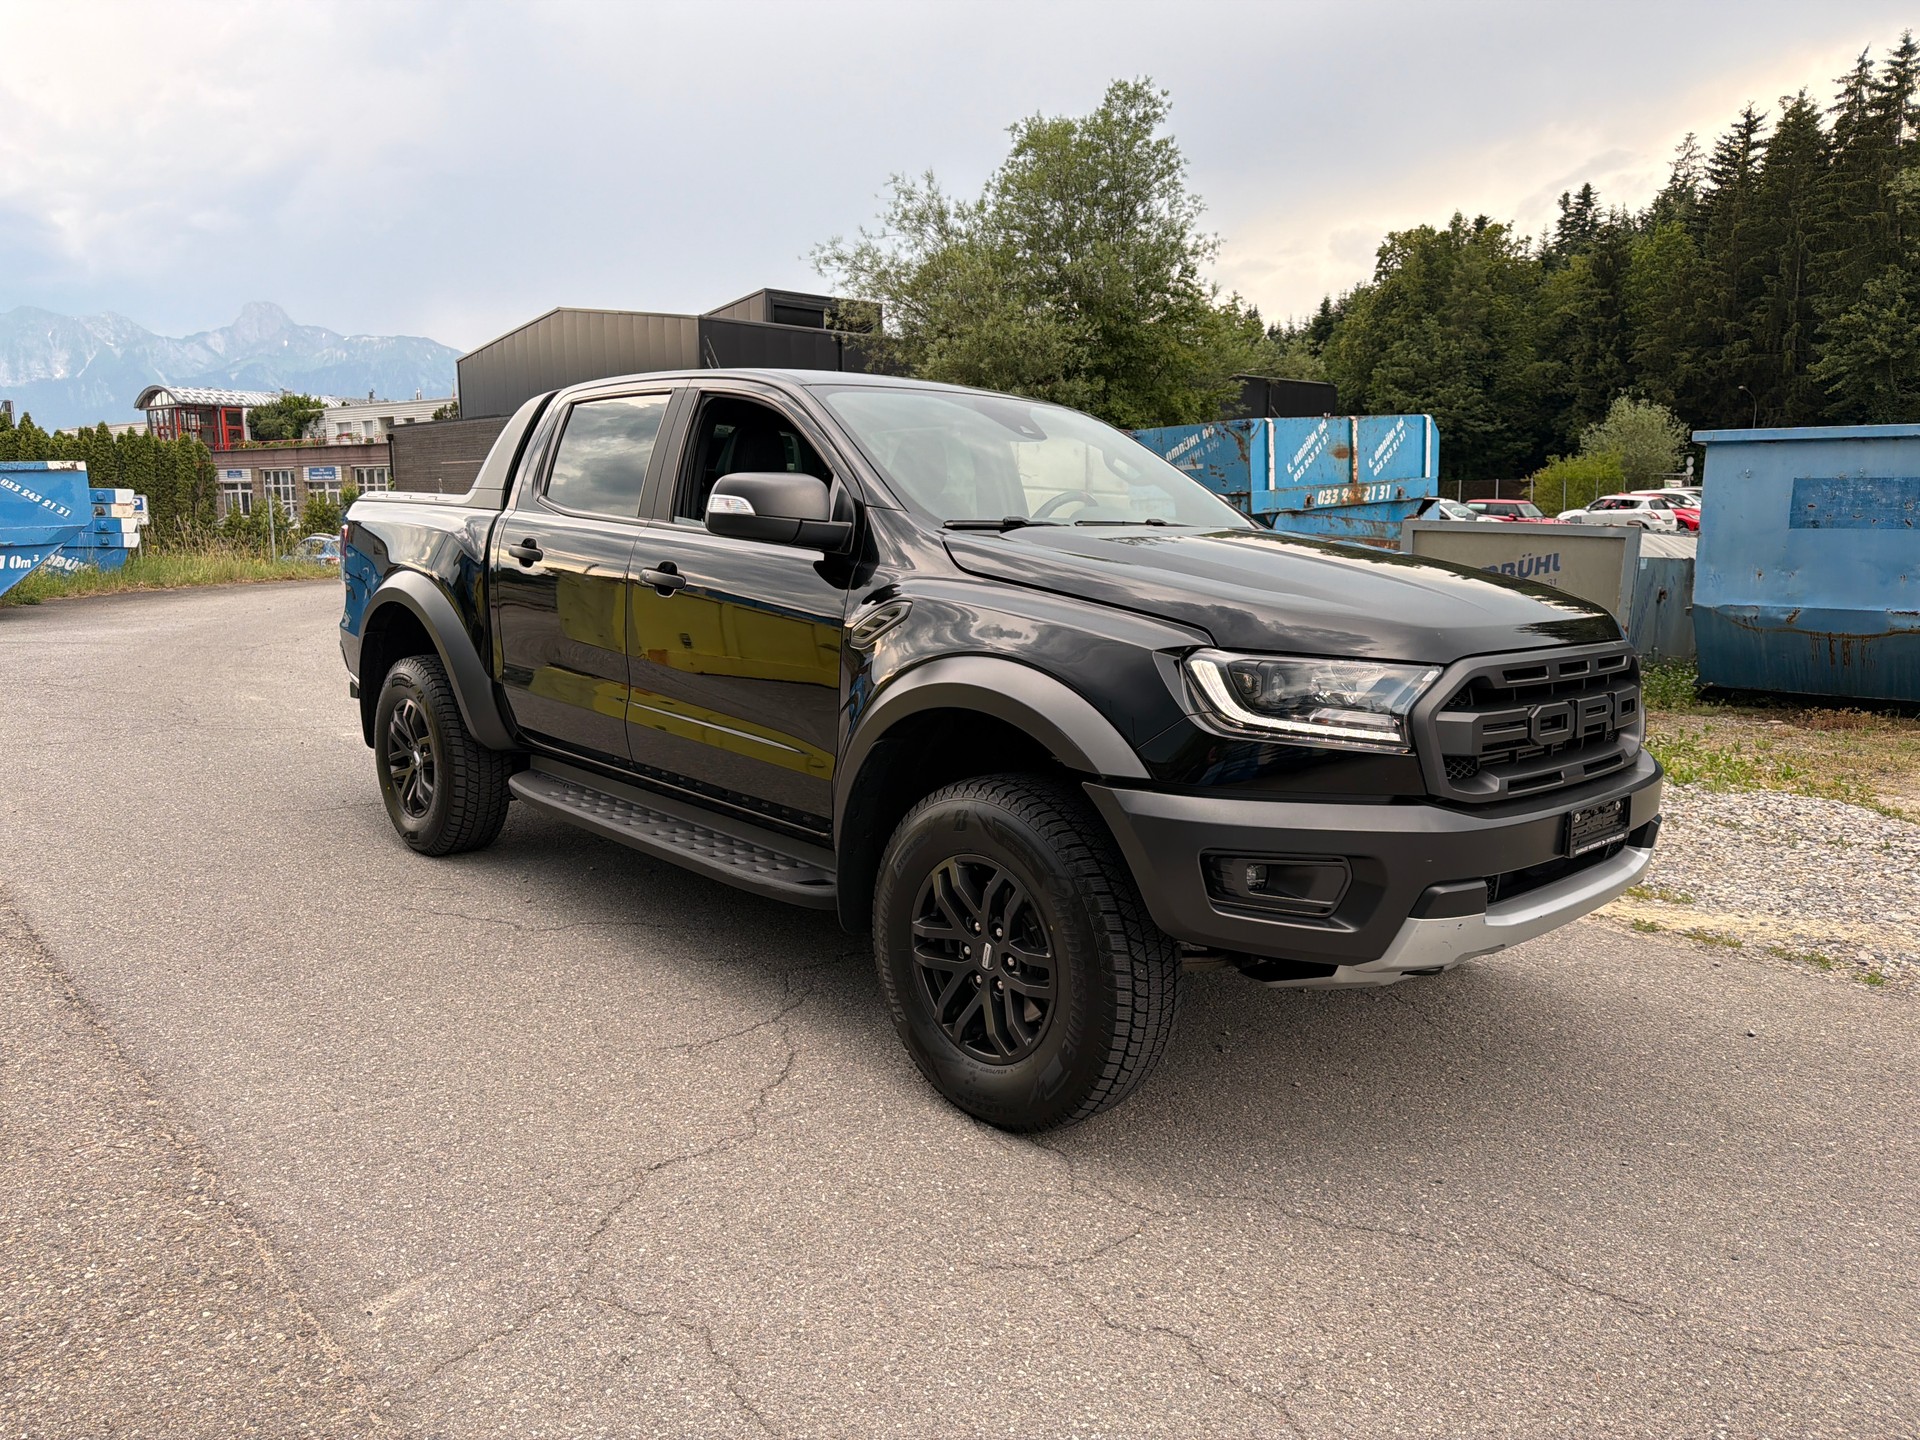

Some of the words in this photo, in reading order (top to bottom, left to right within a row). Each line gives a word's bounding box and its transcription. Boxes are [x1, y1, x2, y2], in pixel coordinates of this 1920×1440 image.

[0, 478, 21, 492] 033
[20, 488, 42, 503] 243
[41, 499, 57, 510] 21
[56, 506, 71, 517] 31
[1317, 488, 1340, 505] 033
[1363, 486, 1377, 502] 21
[1378, 484, 1391, 500] 31
[1481, 553, 1561, 578] BÜHL
[1470, 686, 1640, 755] FORD
